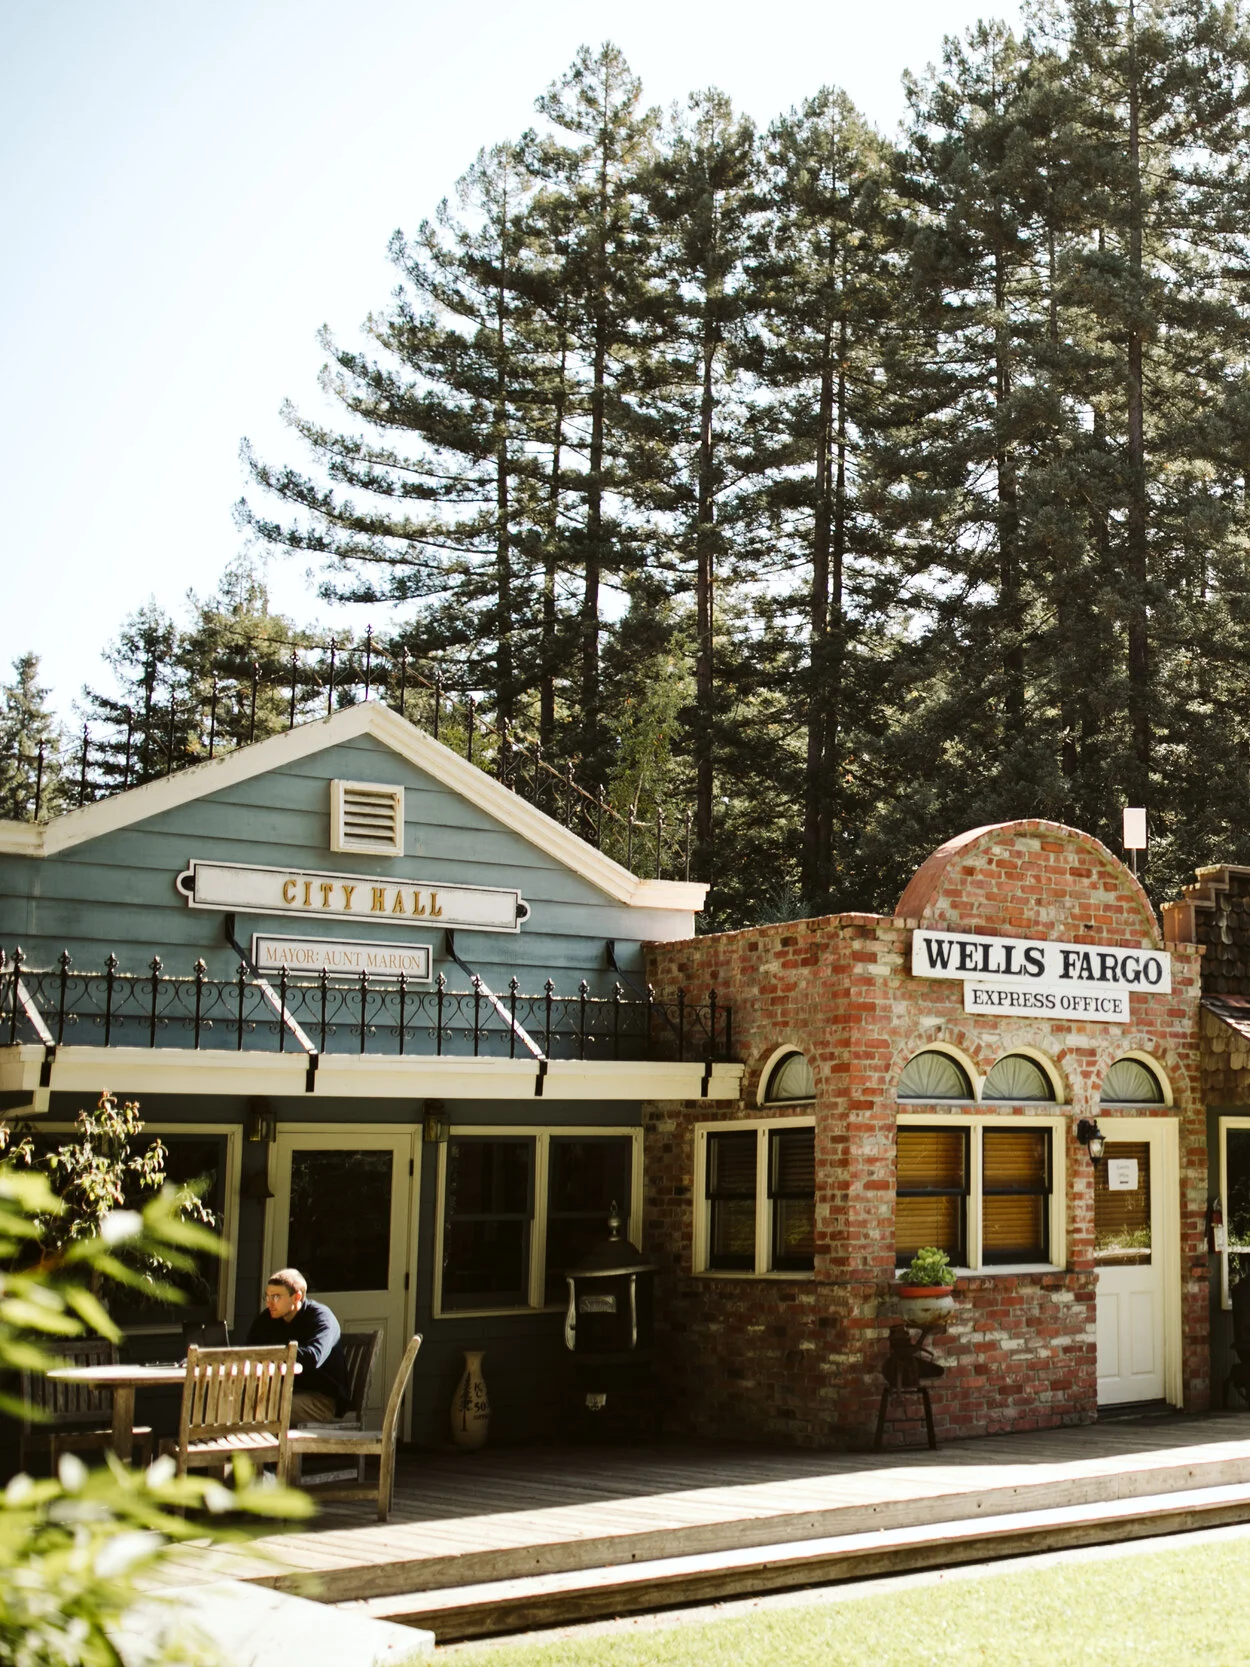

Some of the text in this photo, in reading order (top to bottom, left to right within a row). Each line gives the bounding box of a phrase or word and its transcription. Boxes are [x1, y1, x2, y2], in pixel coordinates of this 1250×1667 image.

[283, 879, 443, 918] CITY HALL
[266, 947, 421, 969] MAYOR: AUNT MARION
[923, 938, 1163, 985] WELLS FARGO
[972, 989, 1122, 1014] EXPRESS OFFICE
